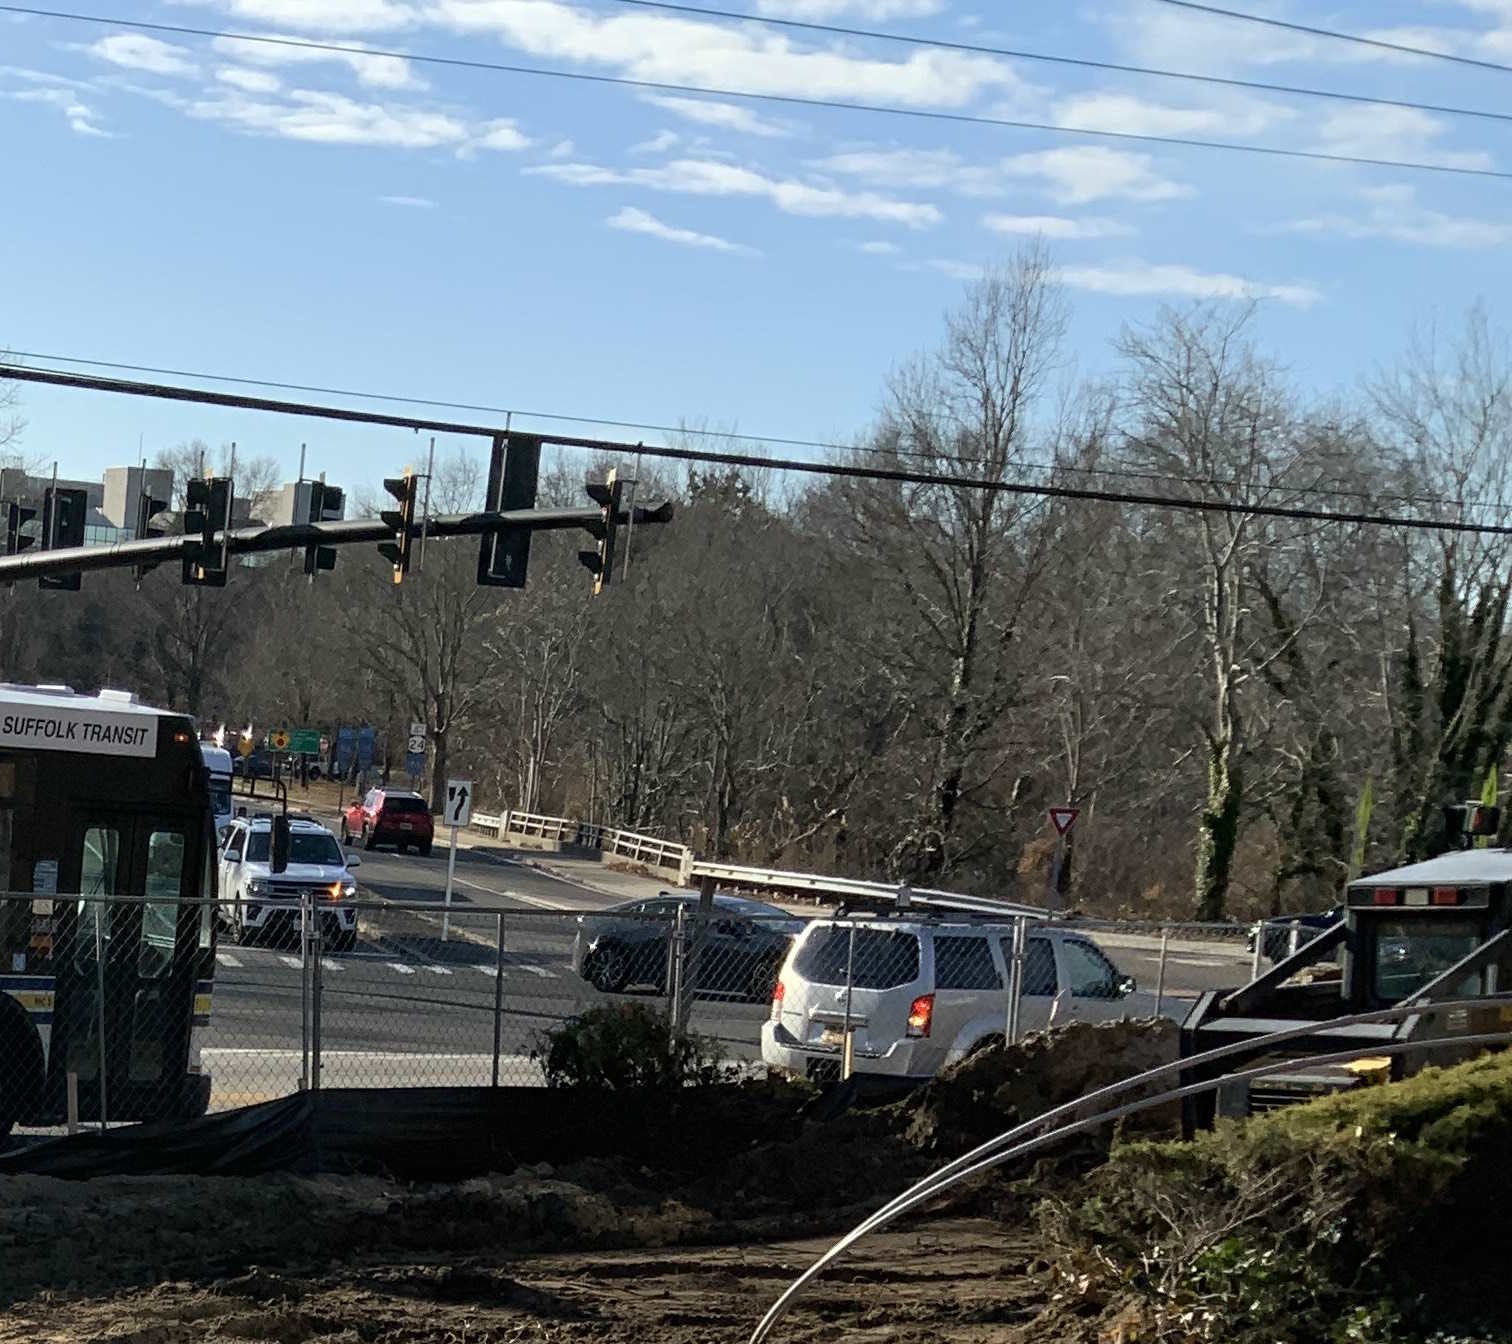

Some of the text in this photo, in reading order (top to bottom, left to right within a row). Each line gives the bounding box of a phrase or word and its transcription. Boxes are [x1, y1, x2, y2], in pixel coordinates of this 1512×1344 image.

[2, 715, 149, 746] SUFFOLK TRANSIT
[410, 739, 424, 750] 24
